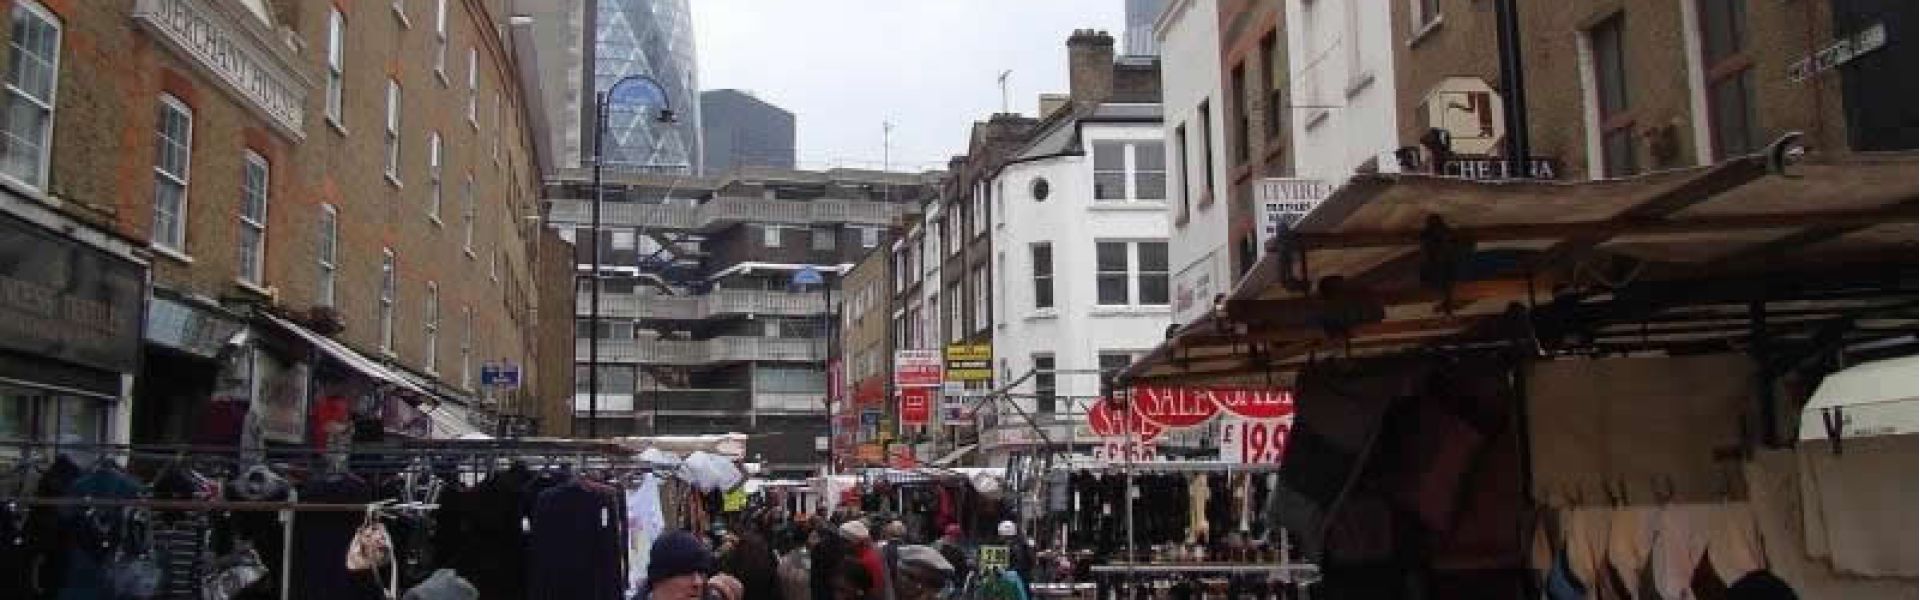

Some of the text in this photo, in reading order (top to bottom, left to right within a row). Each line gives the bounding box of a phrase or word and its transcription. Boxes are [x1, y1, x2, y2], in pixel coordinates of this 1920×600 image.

[249, 62, 299, 121] HOUSE
[1146, 386, 1211, 416] SALE
[1098, 402, 1155, 436] SAE
